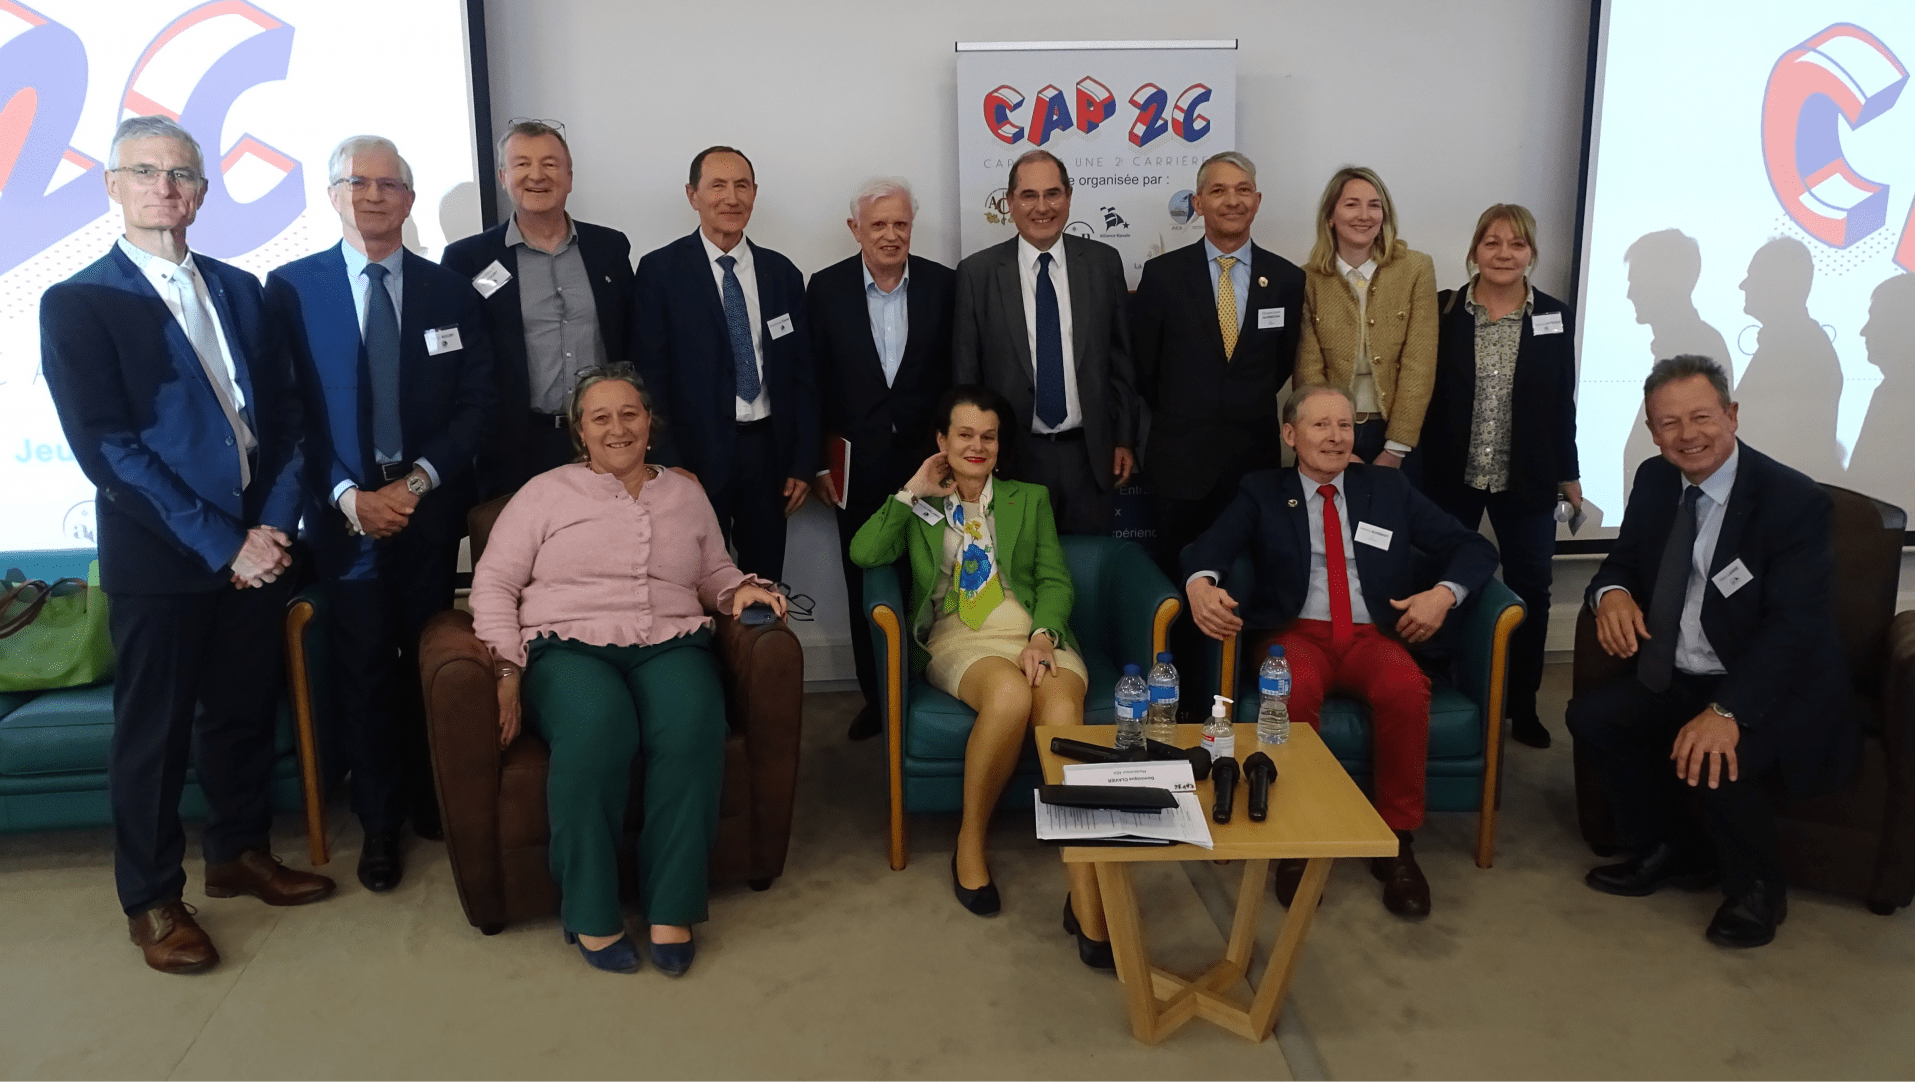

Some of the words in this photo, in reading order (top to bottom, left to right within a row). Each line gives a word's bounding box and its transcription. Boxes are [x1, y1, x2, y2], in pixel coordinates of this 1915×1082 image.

[983, 75, 1116, 147] CAP
[1128, 82, 1212, 147] 2C
[1761, 22, 1915, 273] C
[1075, 156, 1103, 167] UNE
[1078, 174, 1139, 188] organisée
[1142, 175, 1162, 187] par
[14, 437, 76, 464] Jeu
[1119, 485, 1151, 496] Entr
[1112, 527, 1158, 538] périenc
